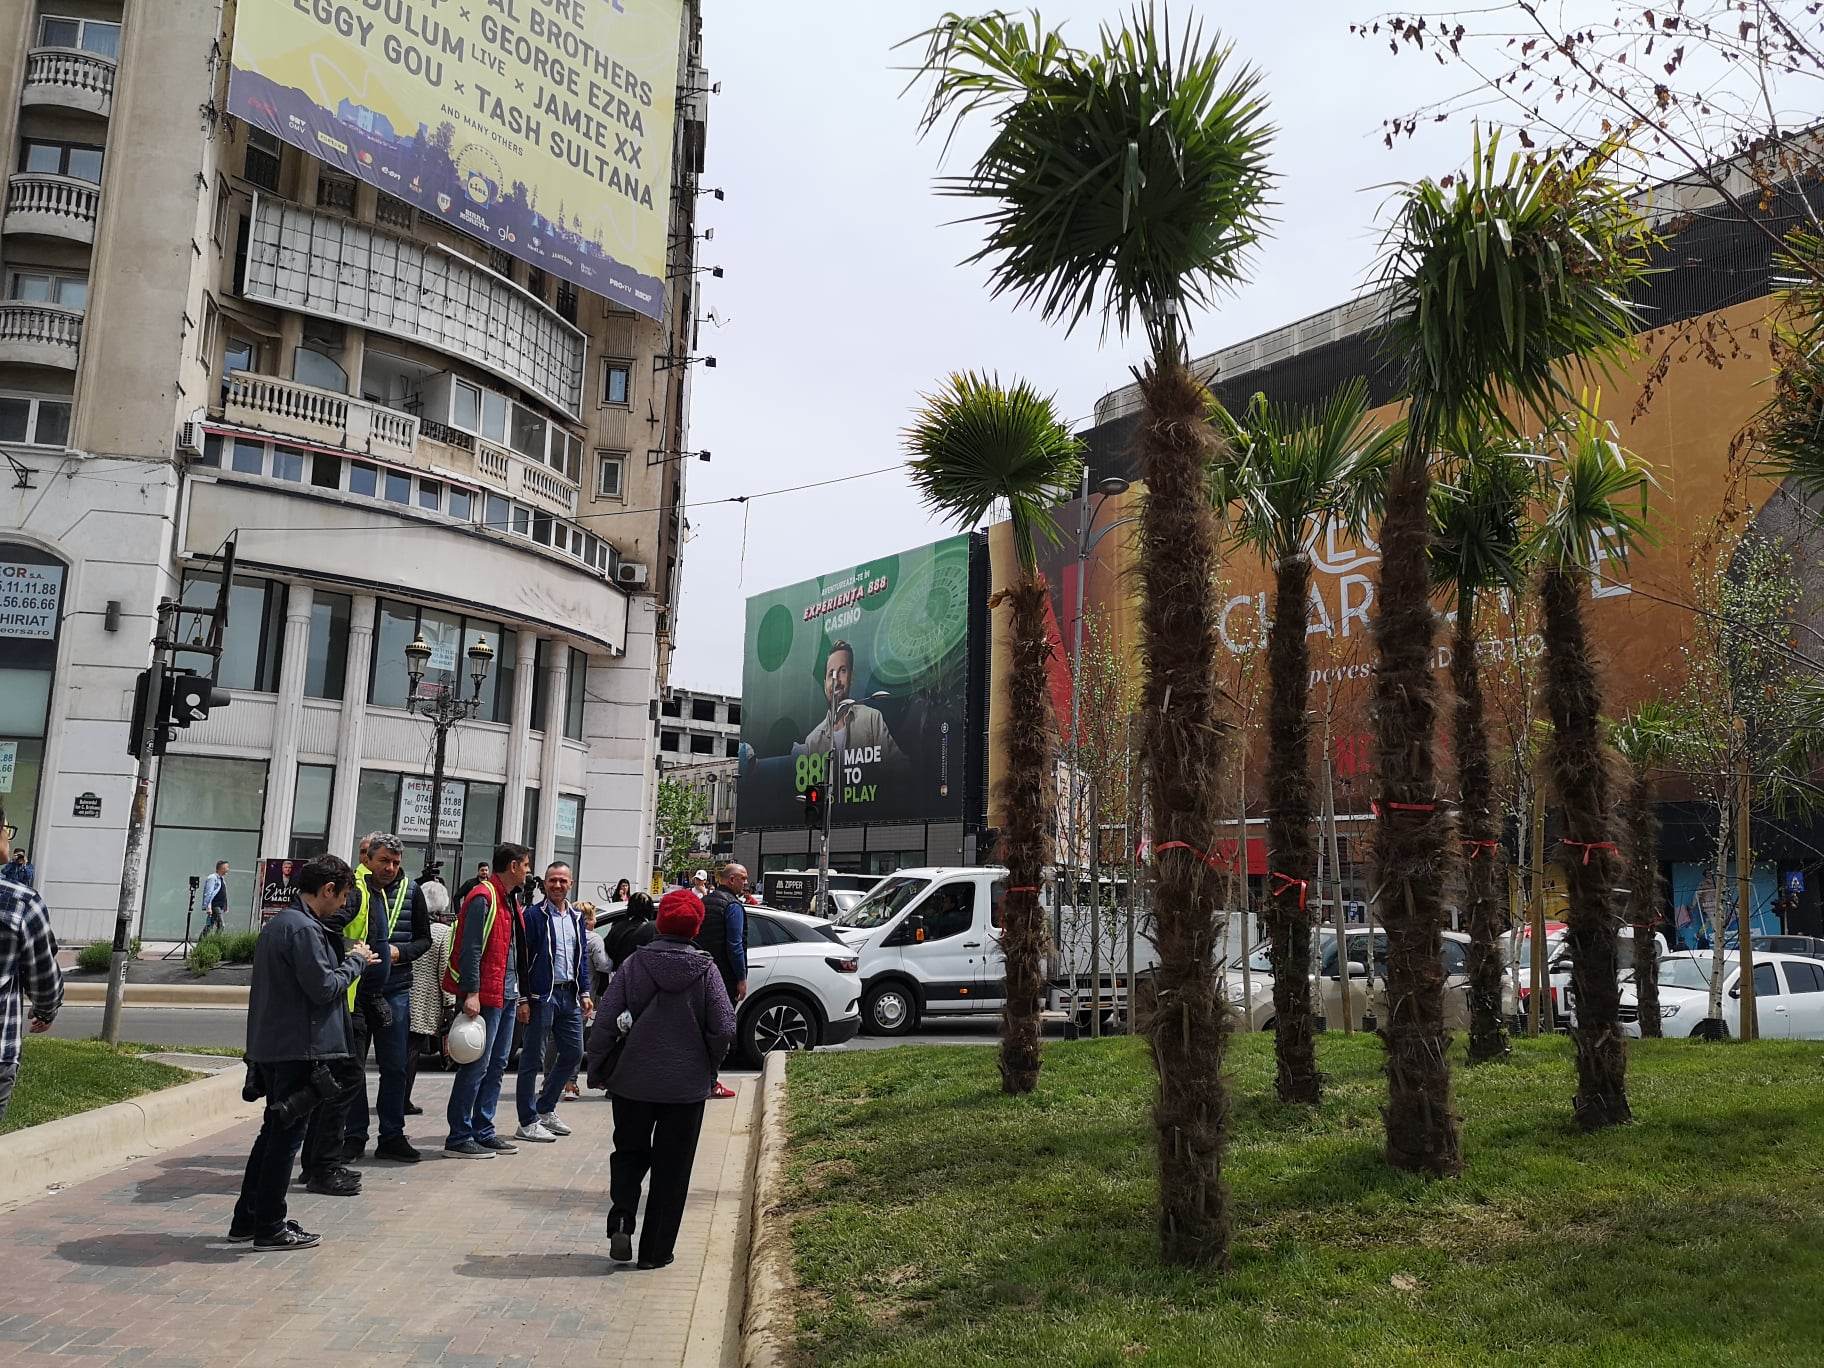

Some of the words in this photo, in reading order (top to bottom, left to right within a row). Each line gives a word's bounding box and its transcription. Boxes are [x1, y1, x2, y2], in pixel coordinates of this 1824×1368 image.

[545, 0, 586, 30] RE
[530, 8, 652, 107] BROTHERS
[481, 15, 581, 97] GEORGE
[588, 80, 644, 138] EZRA
[471, 43, 506, 77] LIVE
[533, 86, 608, 149] JAMIE
[613, 133, 643, 170] XX
[384, 34, 442, 87] GOU
[475, 83, 541, 146] TASH
[550, 131, 653, 211] SULTANA
[440, 104, 461, 119] AND
[463, 115, 489, 134] MANY
[491, 132, 524, 157] OTHERS
[498, 225, 516, 242] glo
[0, 566, 27, 578] OR
[867, 576, 888, 595] 888
[824, 607, 861, 633] CASINO
[844, 745, 882, 766] MADE
[844, 767, 862, 785] TO
[408, 782, 447, 793] METER
[844, 784, 878, 803] PLAY
[403, 816, 416, 825] DE
[417, 815, 459, 828] ÎNCRIAT
[784, 880, 803, 890] ZIPPER
